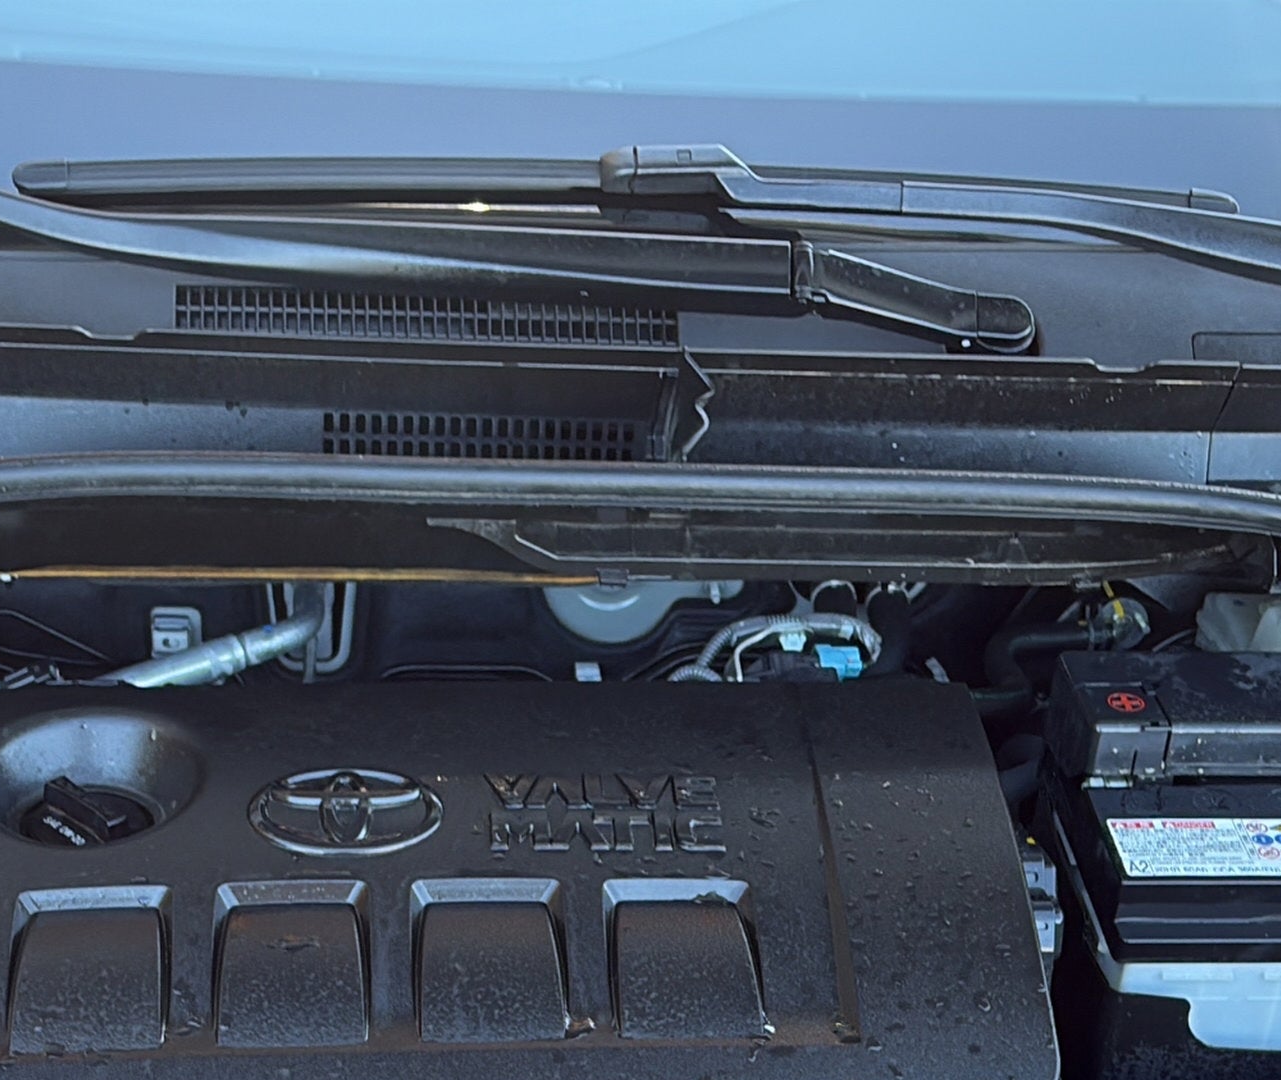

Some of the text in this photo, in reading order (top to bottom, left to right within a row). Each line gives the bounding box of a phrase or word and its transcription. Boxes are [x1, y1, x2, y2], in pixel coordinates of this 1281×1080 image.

[483, 773, 721, 811] VALVE
[488, 811, 727, 852] MATIC
[1129, 860, 1149, 873] A2
